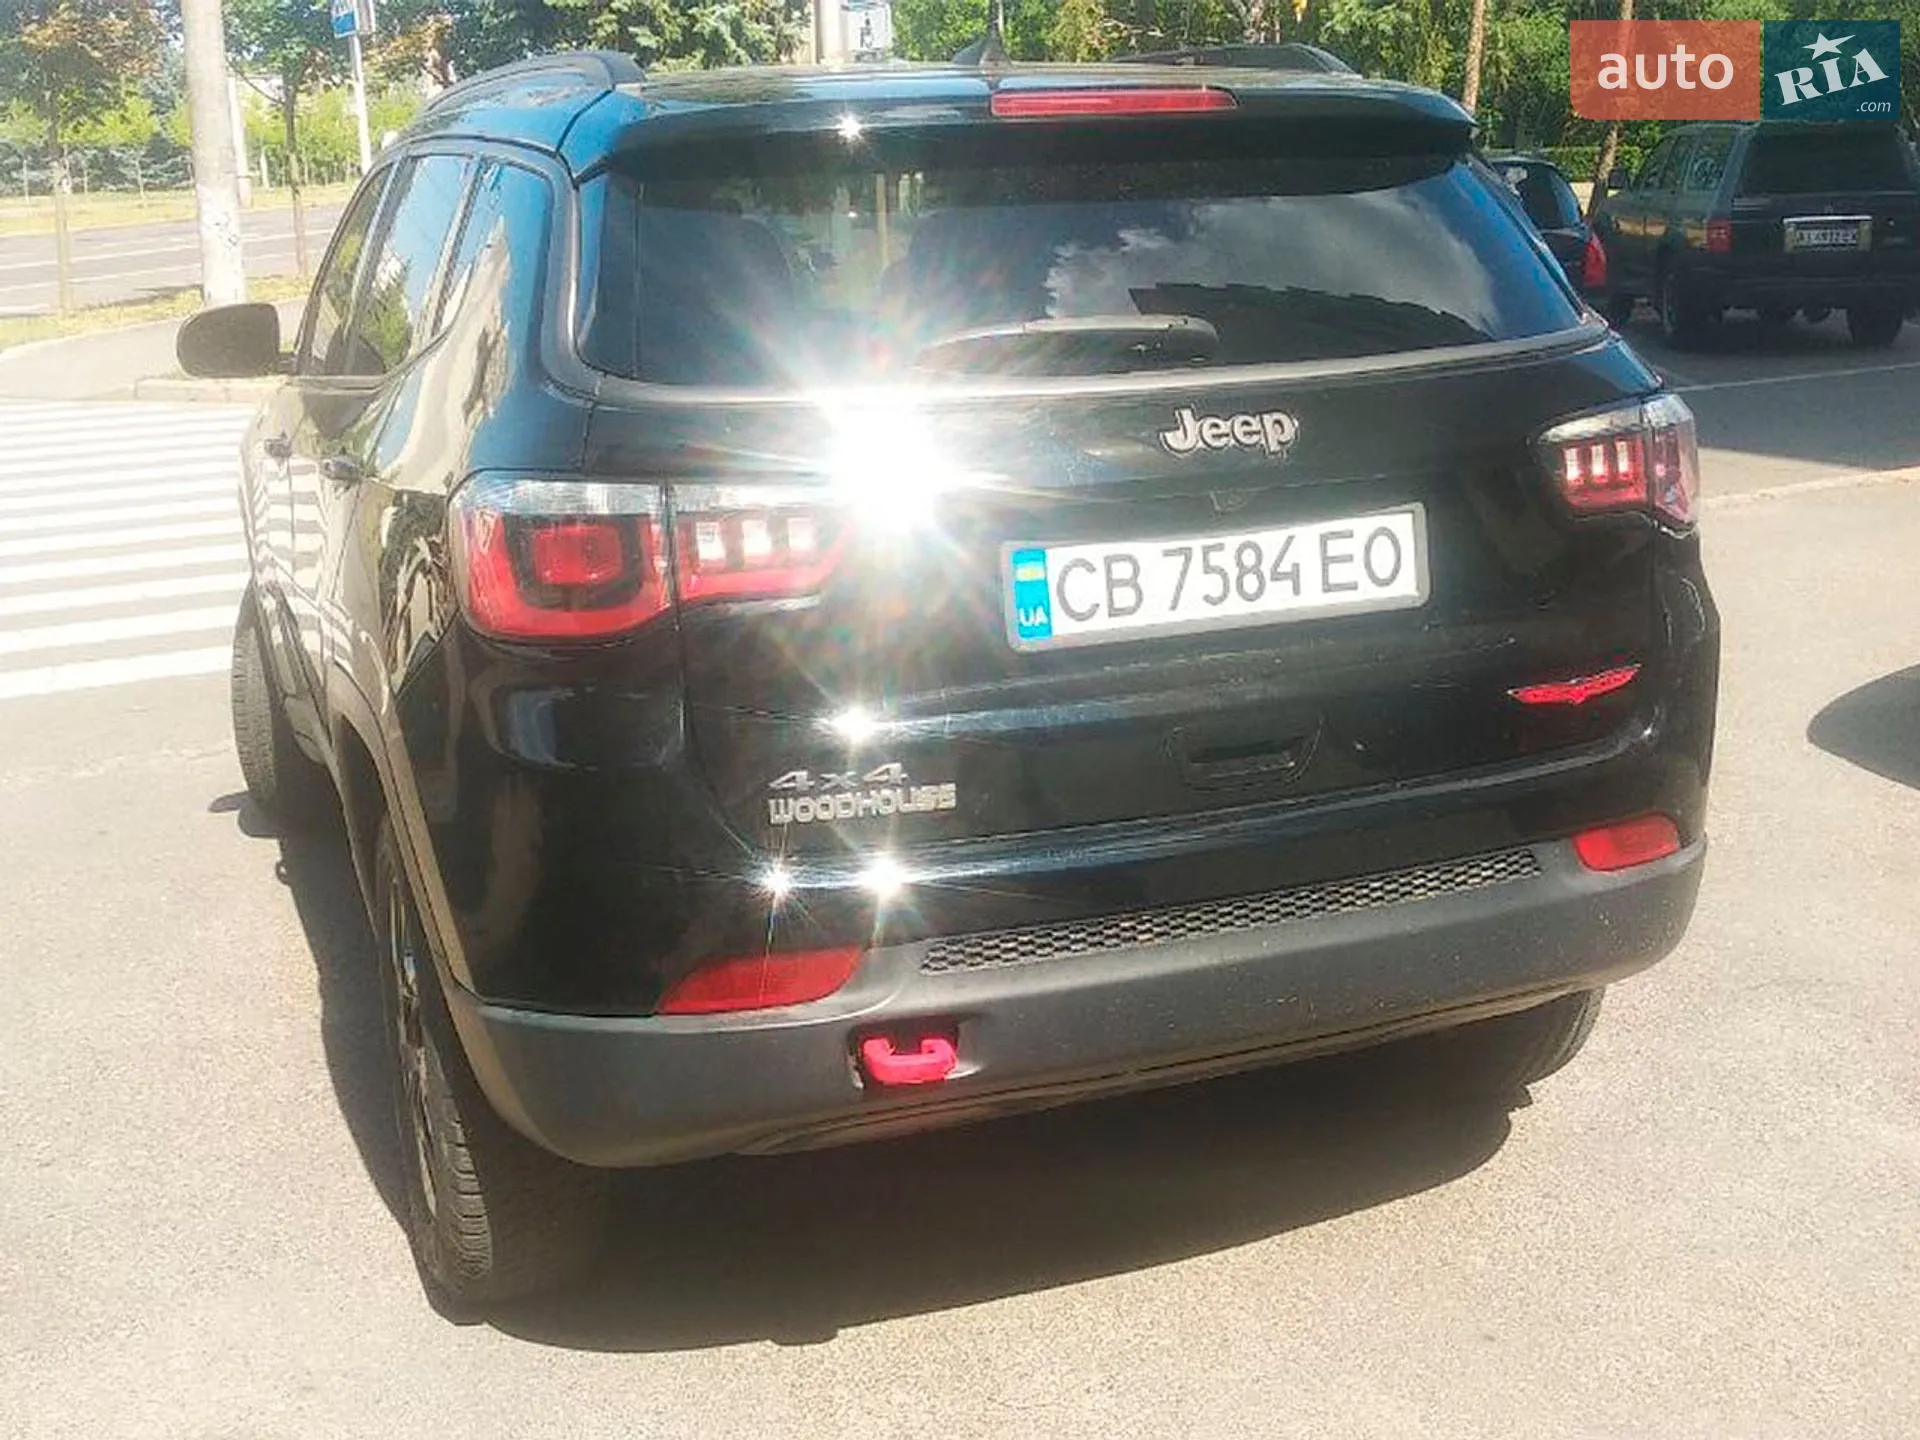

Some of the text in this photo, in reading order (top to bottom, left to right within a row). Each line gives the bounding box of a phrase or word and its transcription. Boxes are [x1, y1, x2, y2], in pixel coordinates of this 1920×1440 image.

[1159, 407, 1299, 457] Jeep
[1055, 526, 1402, 622] CB 7584 EO
[1020, 607, 1049, 626] UA
